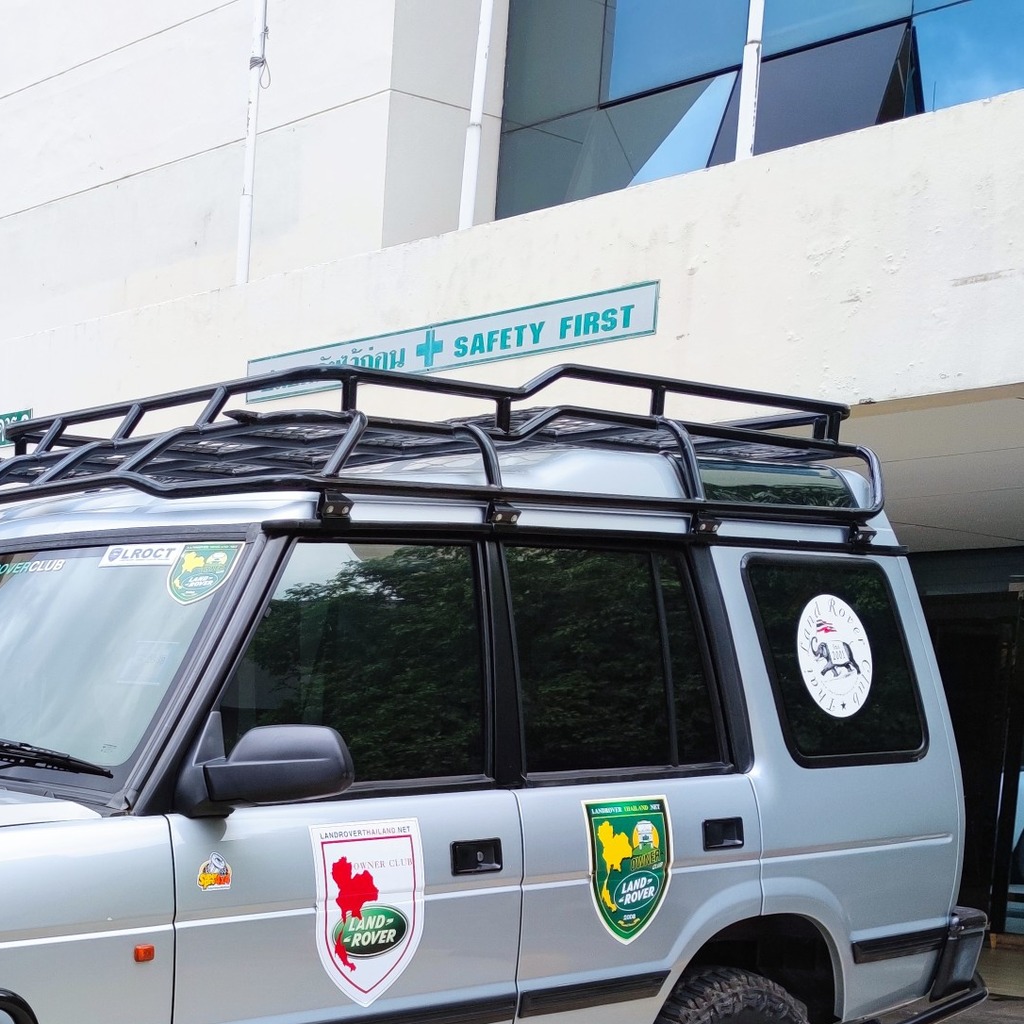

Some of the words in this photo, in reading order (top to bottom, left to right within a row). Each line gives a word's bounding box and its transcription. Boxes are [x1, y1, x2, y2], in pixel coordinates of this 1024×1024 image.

[453, 321, 546, 358] SAFETY
[559, 304, 636, 340] FIRST
[121, 547, 176, 559] LROCT
[591, 807, 623, 815] LANDROVER
[353, 861, 386, 870] OWNER
[389, 857, 413, 867] CLUB
[621, 877, 646, 895] LAND
[624, 885, 655, 905] ROVER
[348, 914, 386, 932] LAND
[351, 929, 397, 947] ROVER
